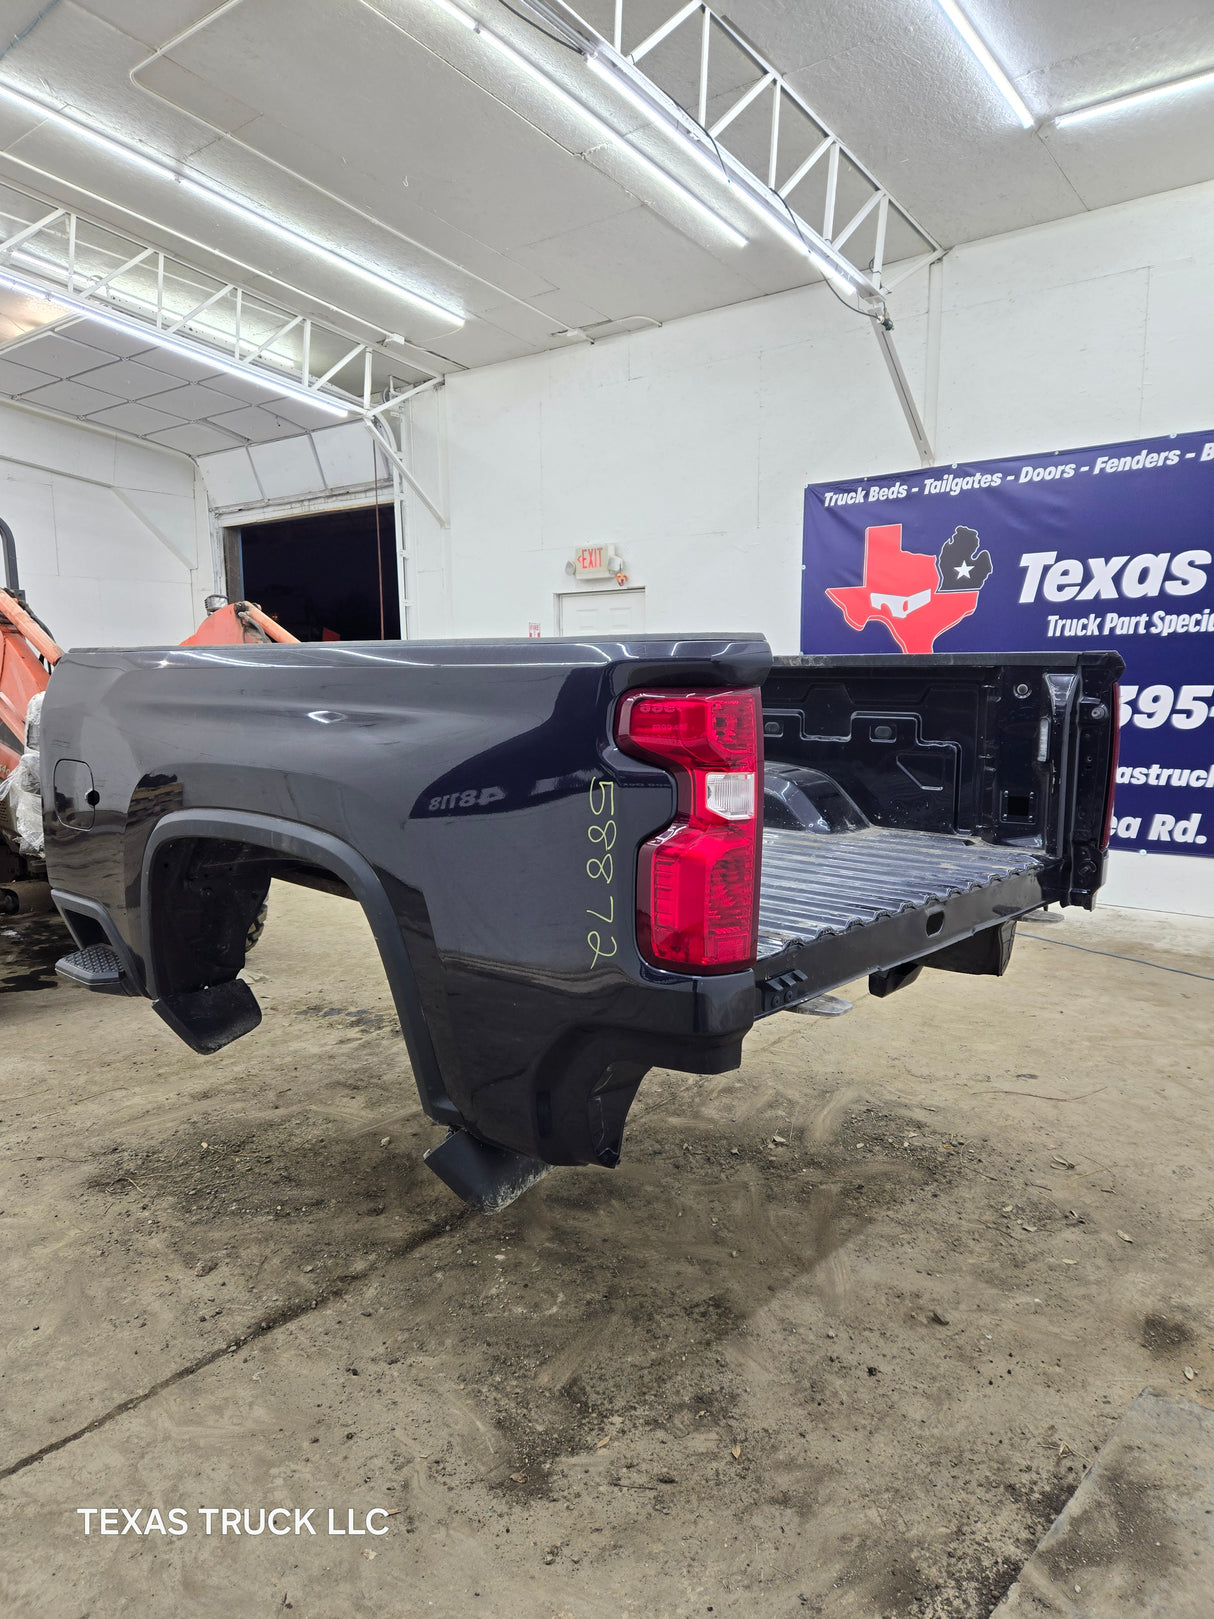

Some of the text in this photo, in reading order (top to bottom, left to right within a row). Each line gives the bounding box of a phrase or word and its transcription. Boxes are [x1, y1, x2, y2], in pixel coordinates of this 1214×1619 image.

[824, 487, 866, 507] Truck
[868, 482, 908, 502] Beds
[923, 472, 1003, 496] Tailgates
[1018, 463, 1076, 483] Doors
[1093, 449, 1181, 475] Fenders
[581, 547, 603, 569] EXIT
[1018, 549, 1212, 603] Texas
[1047, 613, 1102, 637] Truck
[1103, 612, 1149, 635] Part
[1119, 684, 1214, 730] 395
[1147, 813, 1208, 844] Rd.
